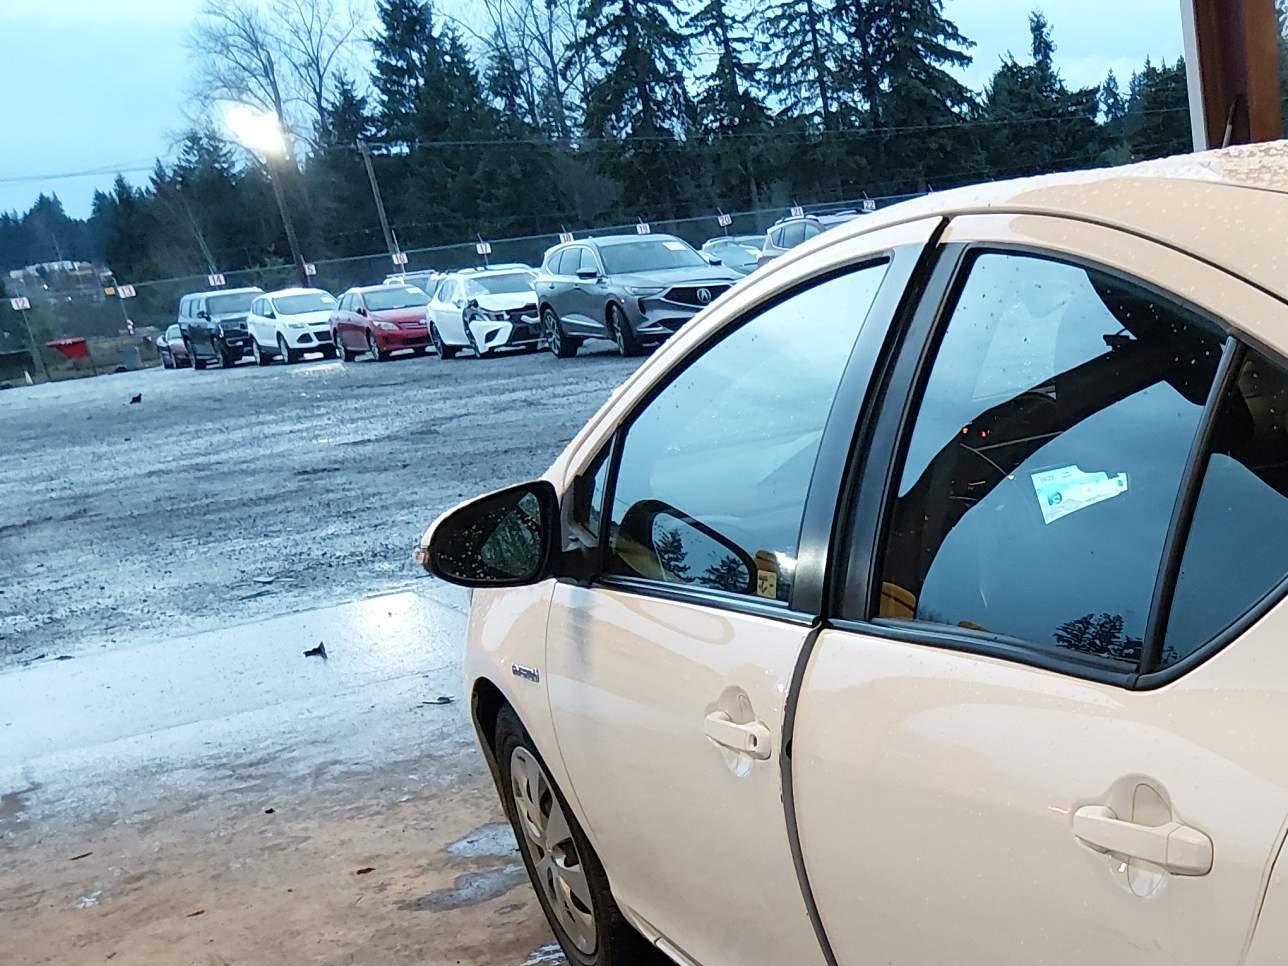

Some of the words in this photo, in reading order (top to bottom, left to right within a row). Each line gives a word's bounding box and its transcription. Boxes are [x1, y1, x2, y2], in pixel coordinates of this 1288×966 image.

[719, 214, 731, 226] 20
[211, 274, 224, 286] 14
[120, 286, 133, 298] 13
